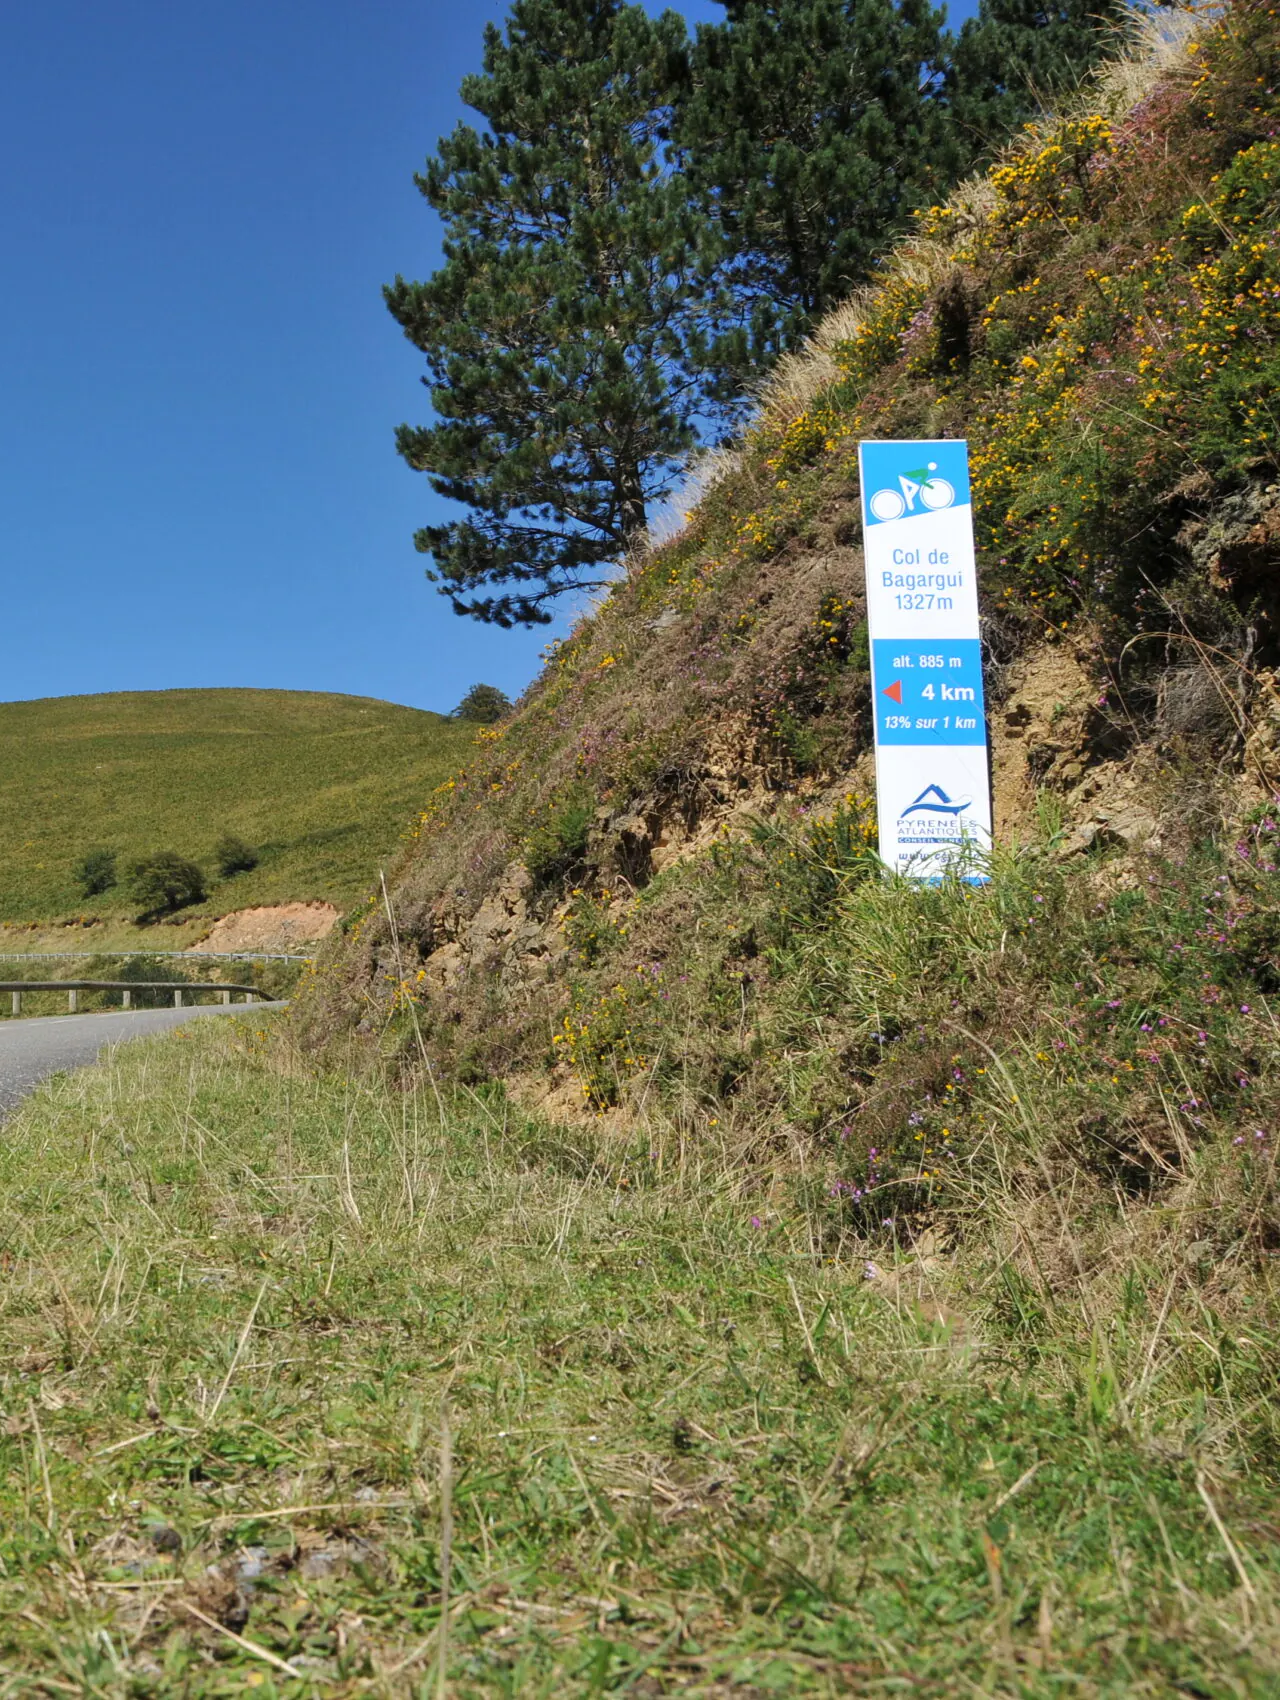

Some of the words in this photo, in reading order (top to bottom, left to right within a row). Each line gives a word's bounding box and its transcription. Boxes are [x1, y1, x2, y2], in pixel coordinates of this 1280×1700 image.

[892, 548, 920, 565] Col
[928, 548, 949, 565] de
[882, 571, 963, 591] Bagargui
[894, 593, 953, 610] 1327m
[893, 655, 914, 668] alt.
[919, 655, 944, 668] 885
[949, 656, 962, 668] m
[921, 683, 935, 701] 4
[941, 683, 975, 701] km
[884, 715, 911, 729] 13%
[915, 718, 938, 729] sur
[943, 716, 949, 729] 1
[955, 716, 977, 729] km
